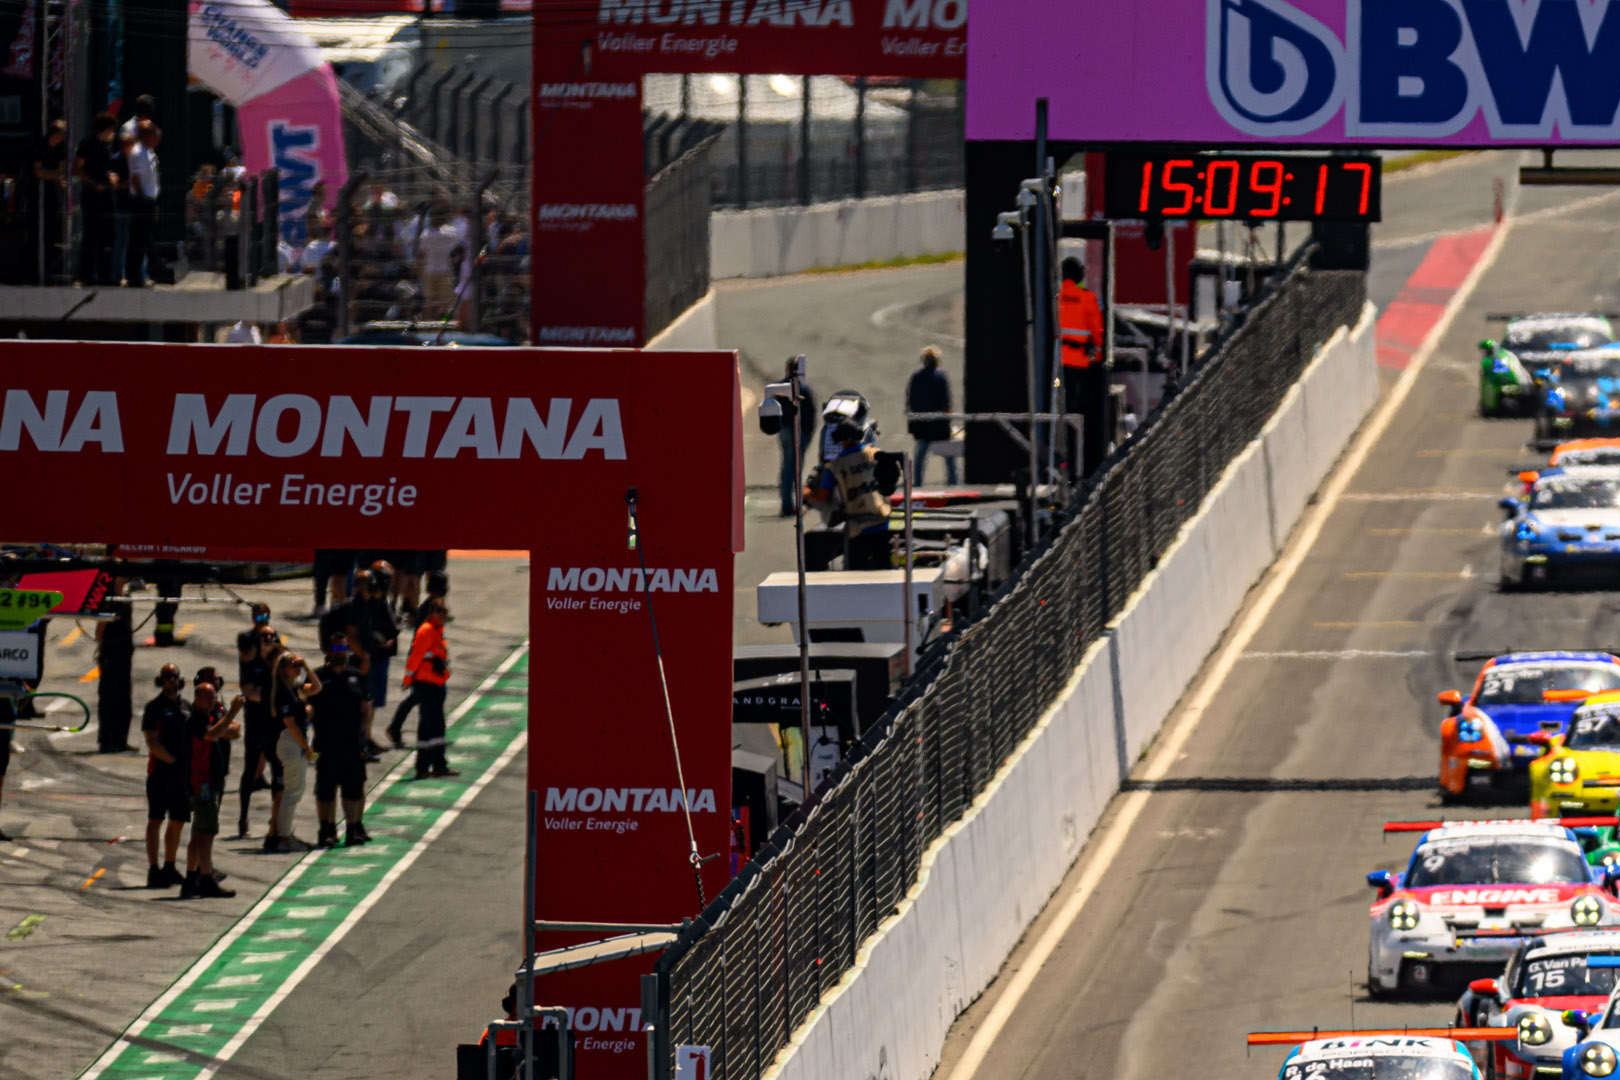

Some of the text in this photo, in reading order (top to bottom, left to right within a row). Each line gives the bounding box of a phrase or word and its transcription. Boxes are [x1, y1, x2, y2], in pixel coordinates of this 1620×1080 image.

[600, 0, 854, 27] MONTANA
[1138, 159, 1372, 218] 15:09:17
[165, 392, 628, 462] MONTANA
[166, 472, 418, 517] Voller Energie
[546, 566, 720, 594] MONTANA
[546, 596, 642, 614] Voller Energie
[544, 787, 717, 813] MONTANA
[543, 817, 639, 836] Voller Energie
[1423, 855, 1445, 872] 9
[1430, 888, 1560, 906] ENGINE
[1543, 959, 1570, 971] Van
[1529, 969, 1566, 990] 15
[582, 1037, 636, 1054] Energie
[1304, 1062, 1327, 1074] de
[1330, 1058, 1374, 1069] Haan
